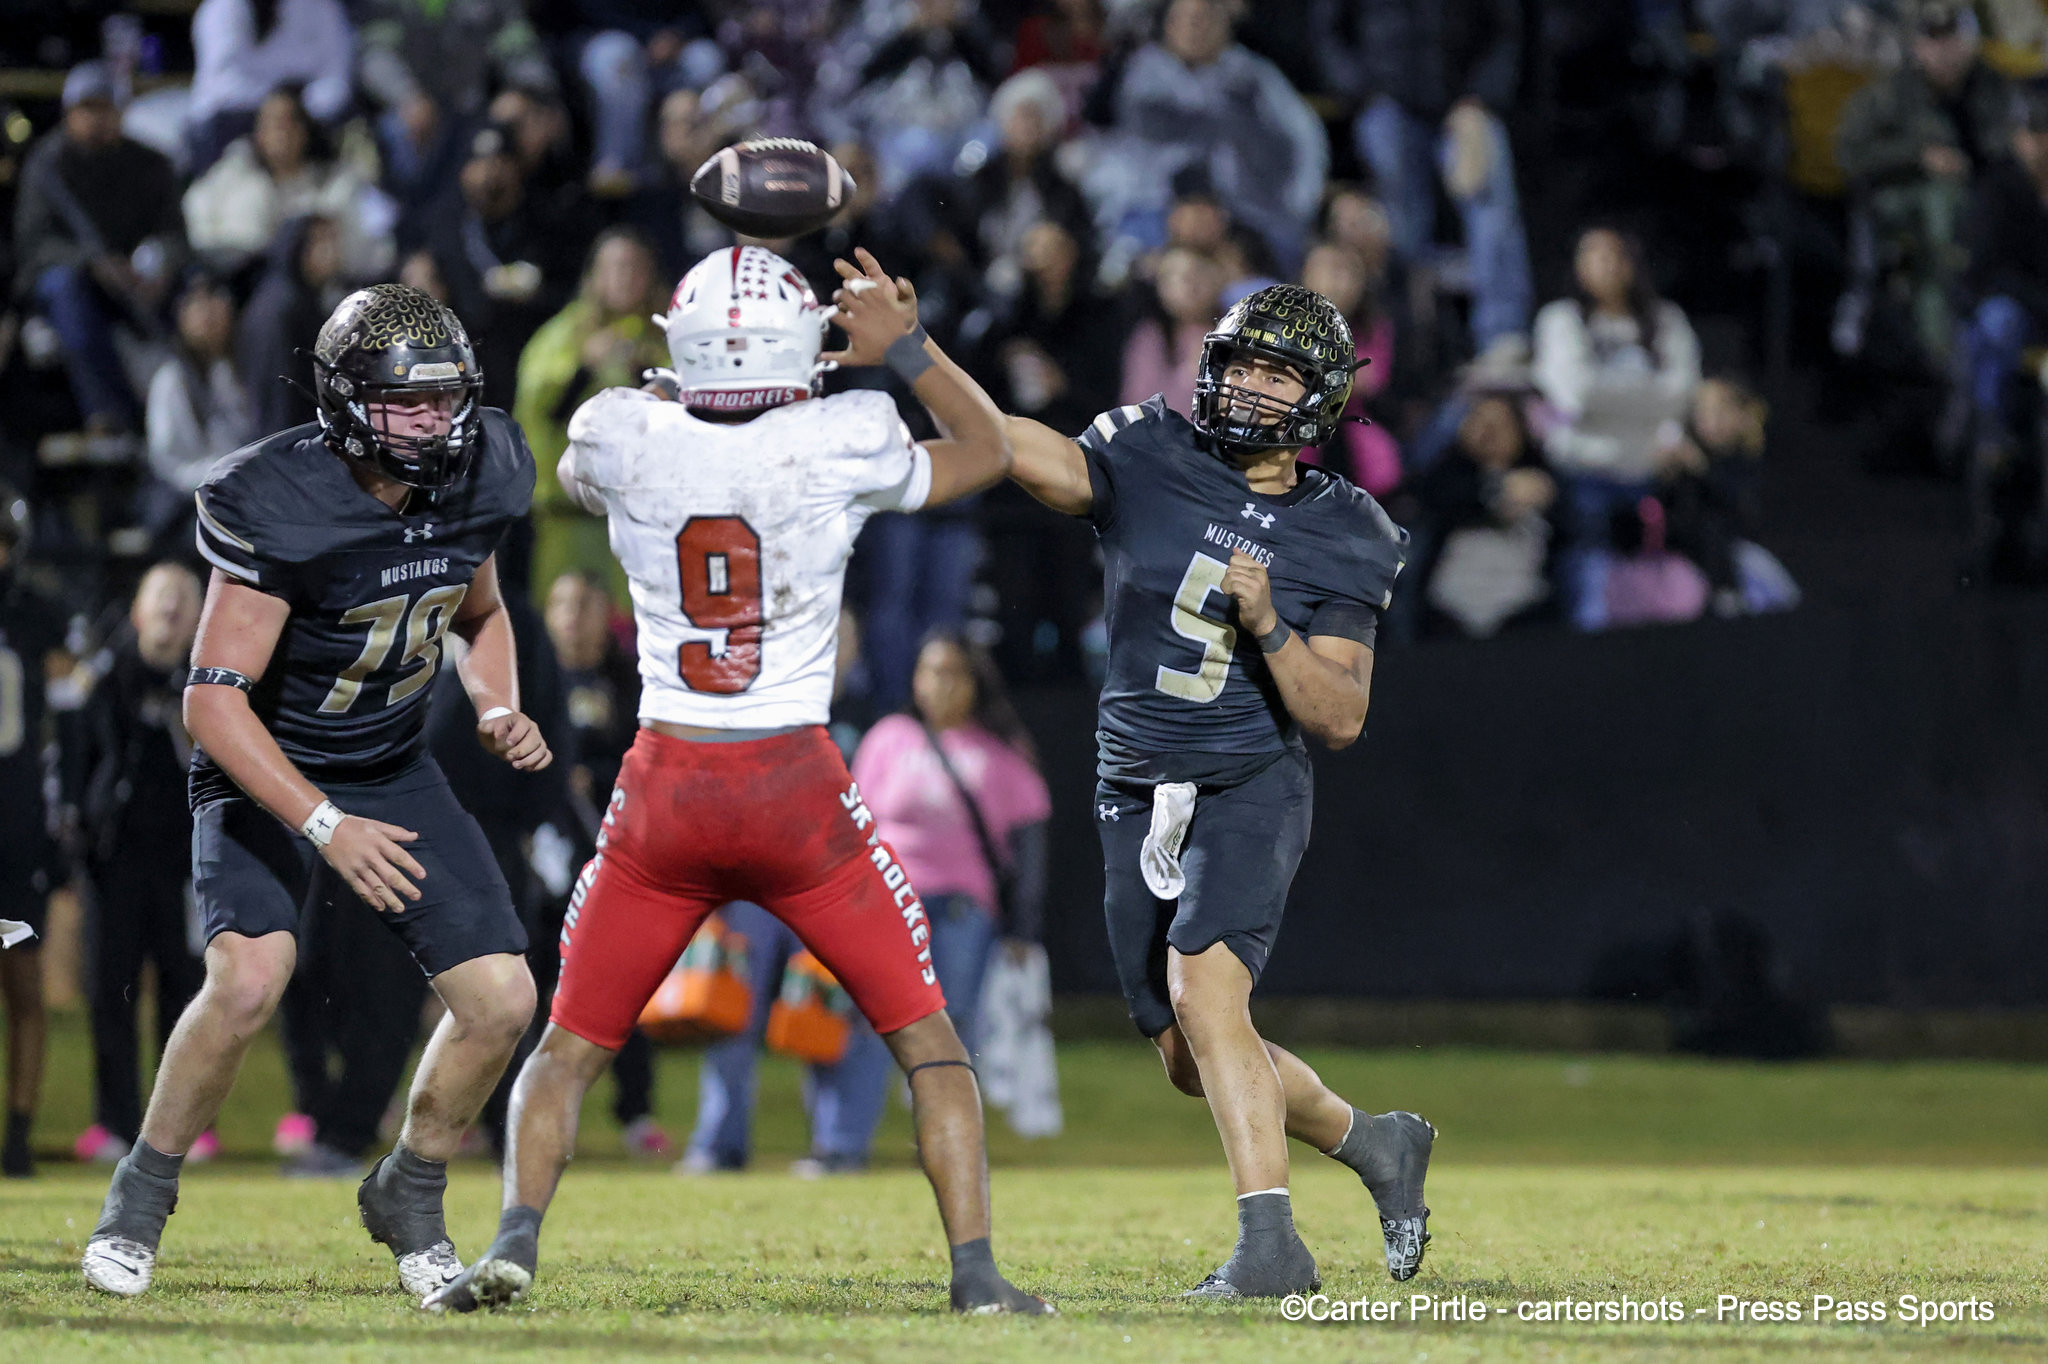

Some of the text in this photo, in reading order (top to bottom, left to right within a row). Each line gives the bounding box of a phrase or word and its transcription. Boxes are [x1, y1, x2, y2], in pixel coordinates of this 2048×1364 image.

[1241, 326, 1262, 340] TEAM
[687, 387, 796, 407] SKYROCKETS
[1203, 523, 1275, 568] MUSTANGS
[381, 557, 449, 587] MUSTANGS
[675, 514, 763, 694] 9
[317, 583, 468, 713] 79
[1155, 551, 1237, 703] 5
